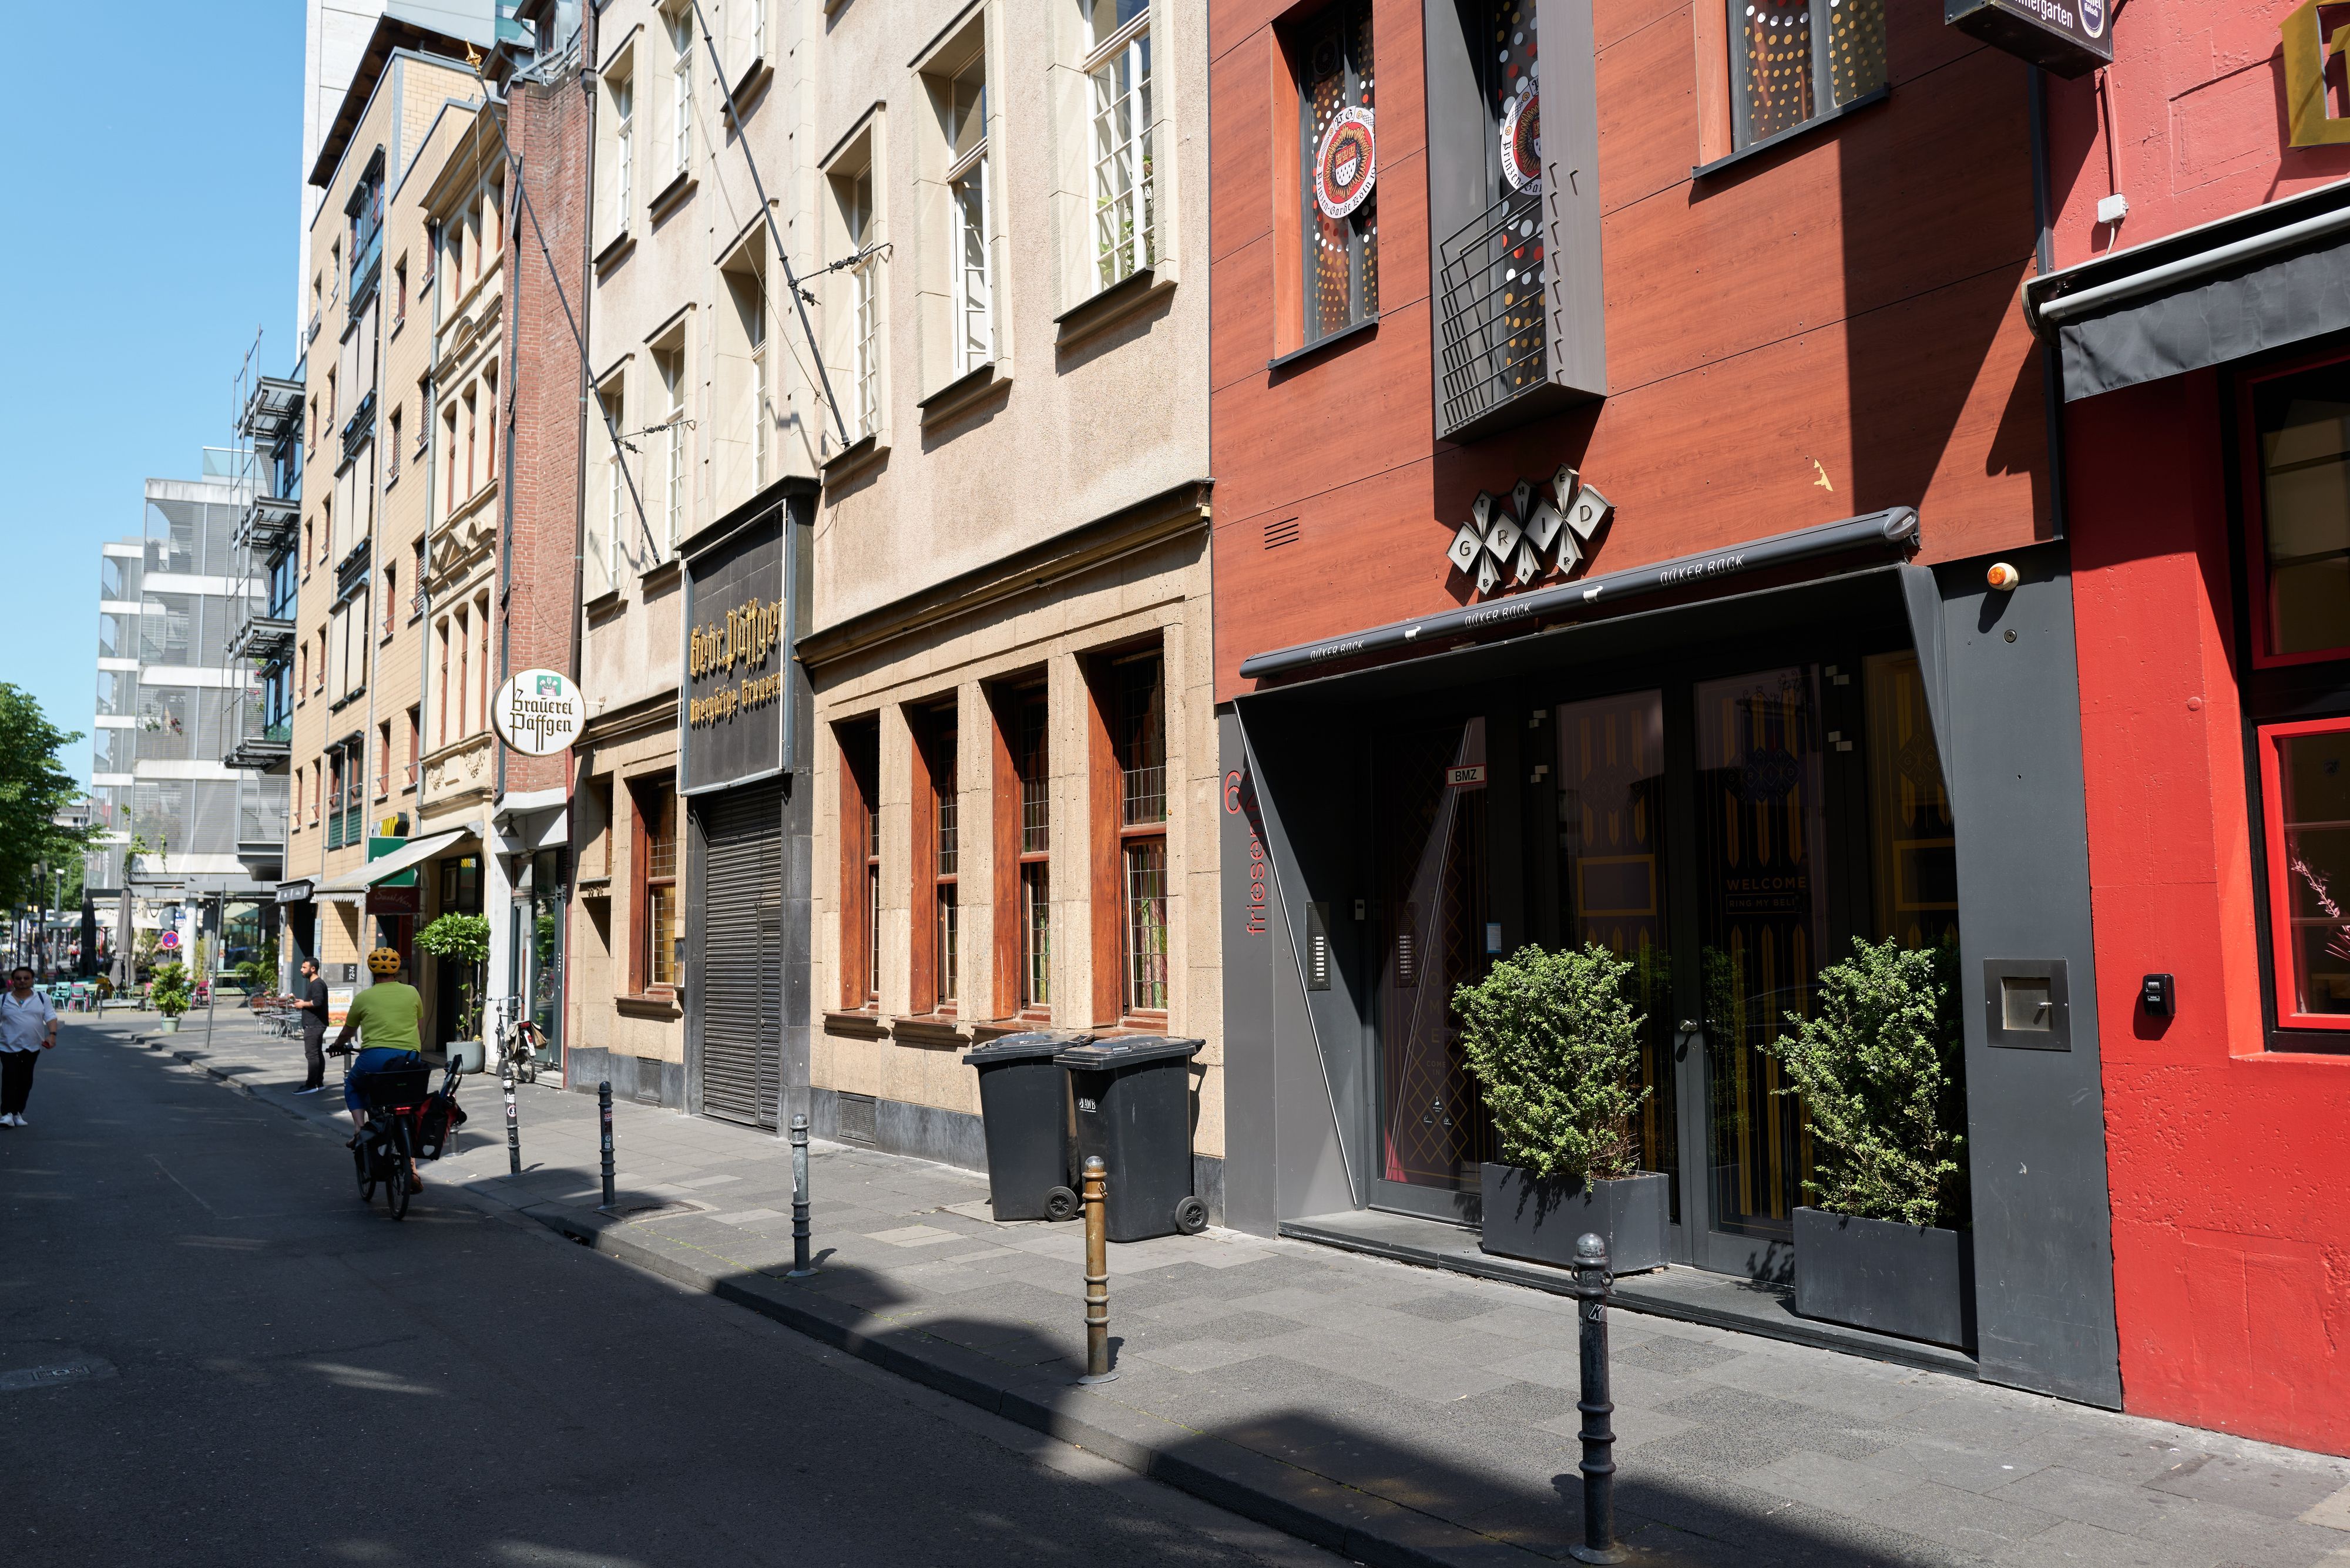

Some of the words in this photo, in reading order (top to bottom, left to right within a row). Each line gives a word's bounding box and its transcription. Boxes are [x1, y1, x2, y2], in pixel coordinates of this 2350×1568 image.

[2015, 0, 2073, 28] ergarten
[1459, 505, 1593, 556] GRID
[1707, 554, 1745, 576] BOCK
[1502, 602, 1533, 620] BOCK
[1340, 639, 1365, 656] BOCK
[512, 677, 573, 715] Brauerei
[509, 711, 573, 752] Päffgen
[1455, 768, 1477, 781] BMZ
[1726, 876, 1807, 891] WELCOME
[1756, 899, 1769, 907] MY
[1084, 1098, 1096, 1110] AWB
